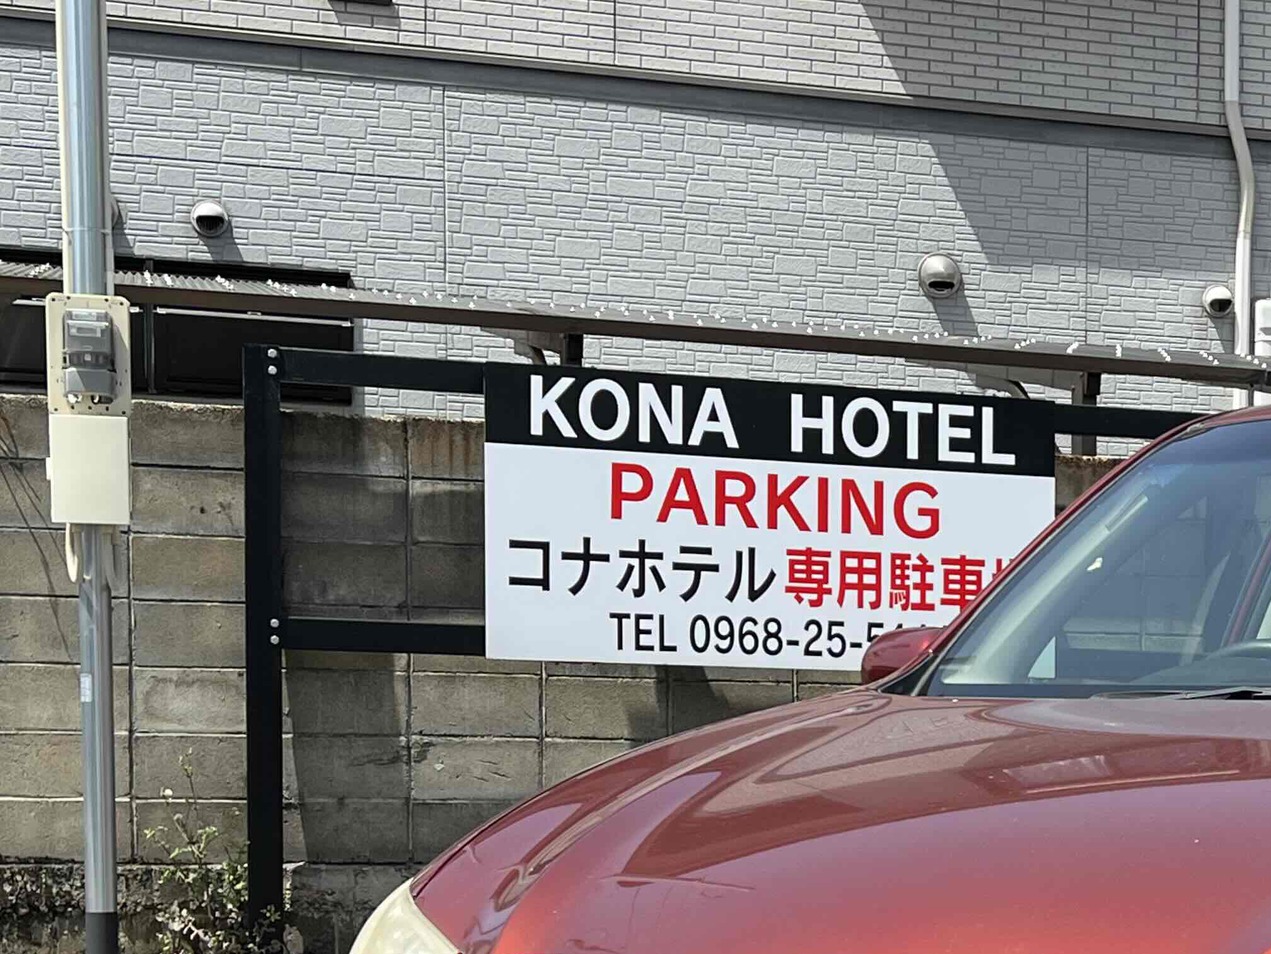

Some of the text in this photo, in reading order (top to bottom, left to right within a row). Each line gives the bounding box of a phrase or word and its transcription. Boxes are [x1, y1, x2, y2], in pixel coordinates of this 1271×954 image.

[529, 374, 1017, 466] KONA HOTEL
[609, 462, 941, 539] PARKING
[508, 537, 1015, 613] コナホテル専用駐車
[609, 612, 678, 653] TEL
